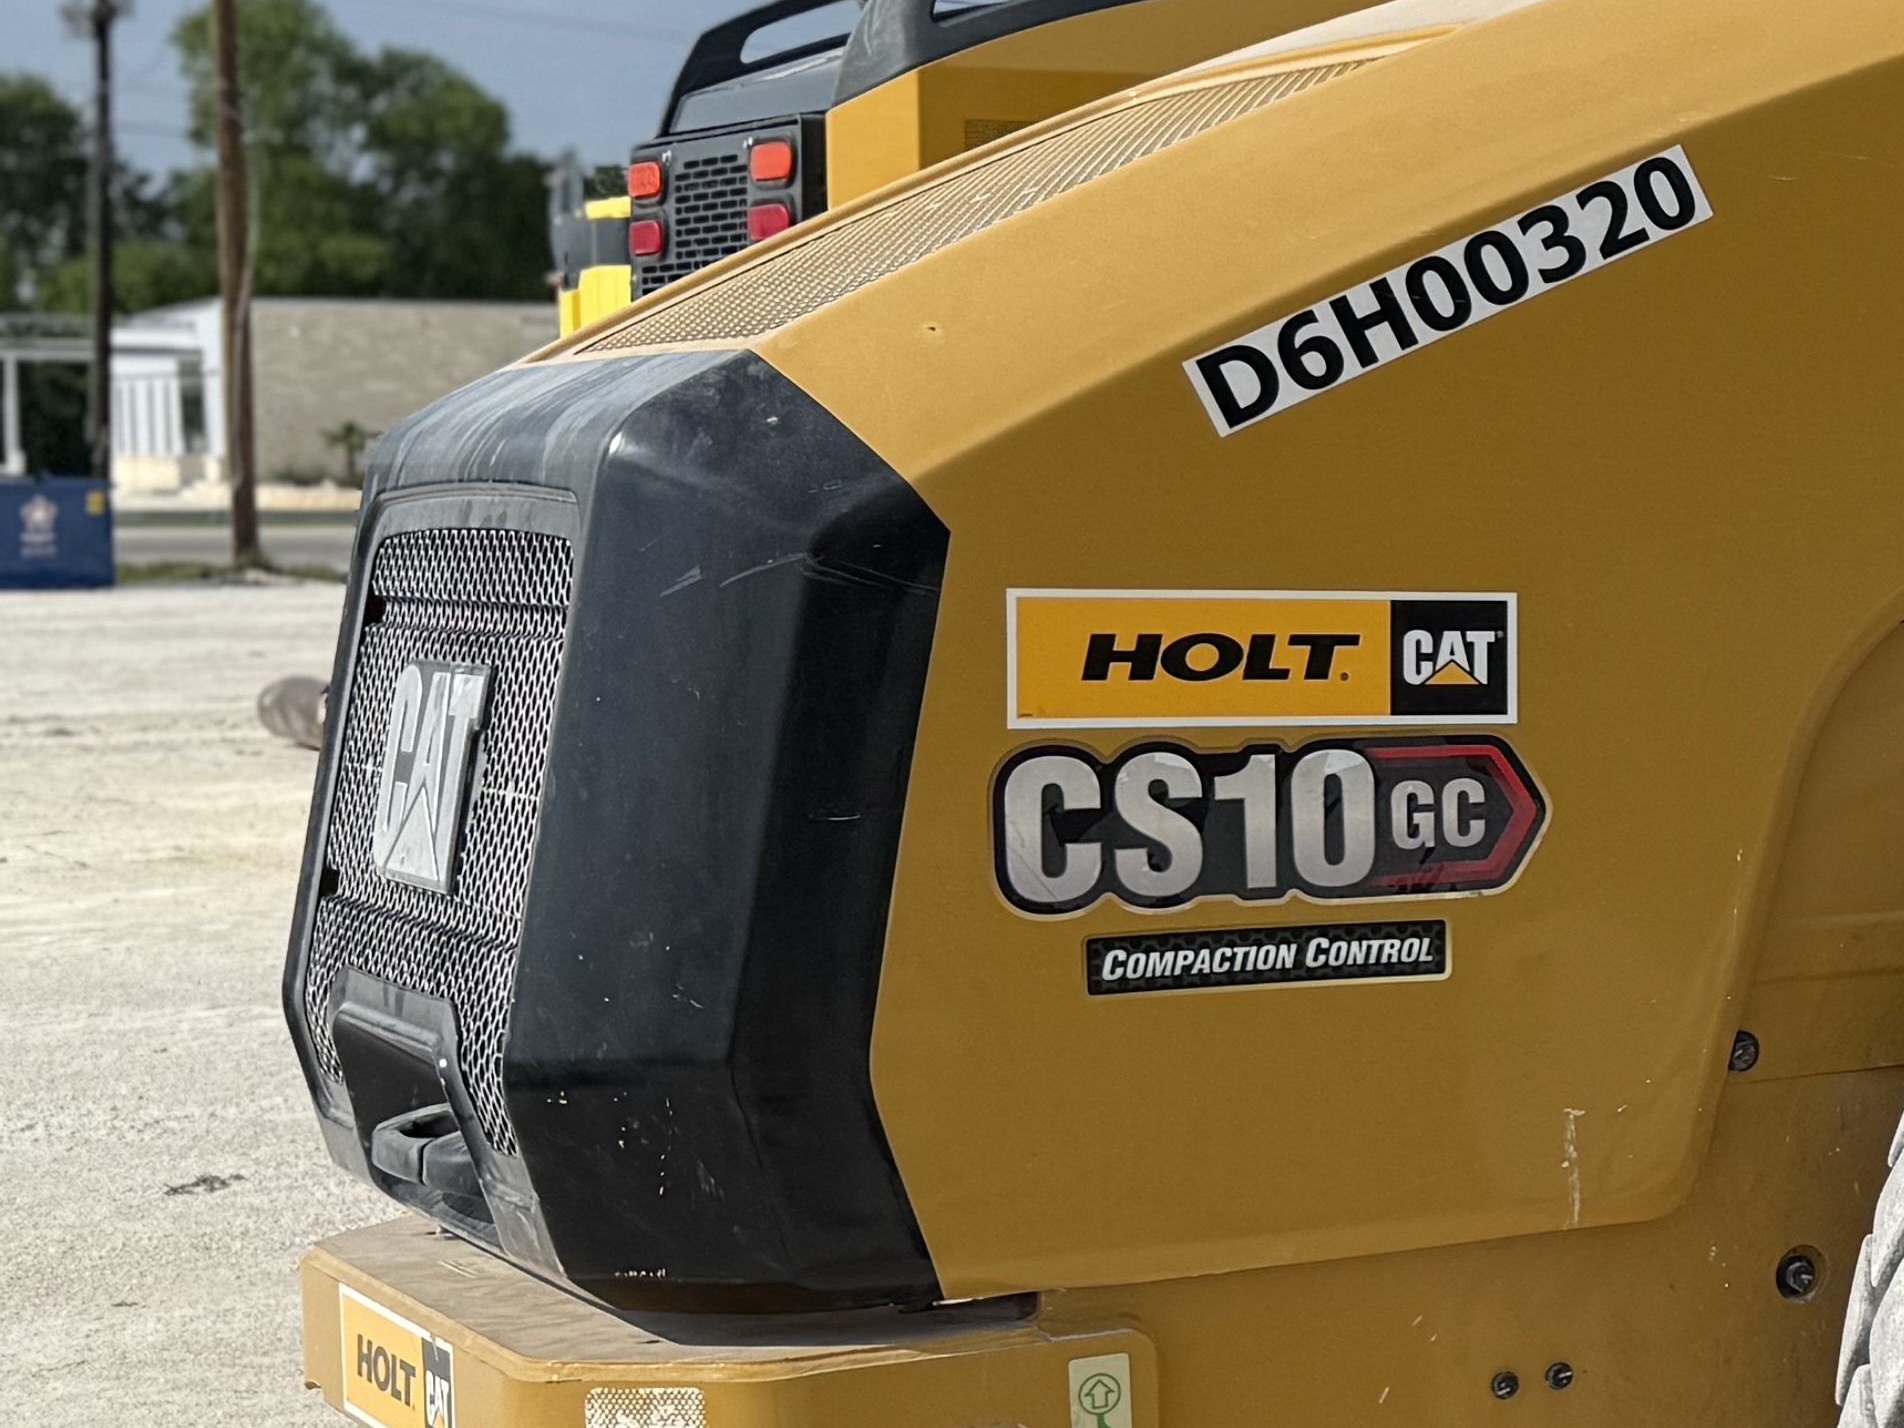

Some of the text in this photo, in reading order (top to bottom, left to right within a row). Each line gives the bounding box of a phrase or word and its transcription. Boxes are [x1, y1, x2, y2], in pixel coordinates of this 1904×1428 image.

[1195, 156, 1697, 430] D6H00320
[1402, 629, 1497, 686] CAT
[373, 663, 487, 892] CAT
[1003, 748, 1487, 904] CS10 GC
[1101, 933, 1434, 981] COMPACTION CONTROL
